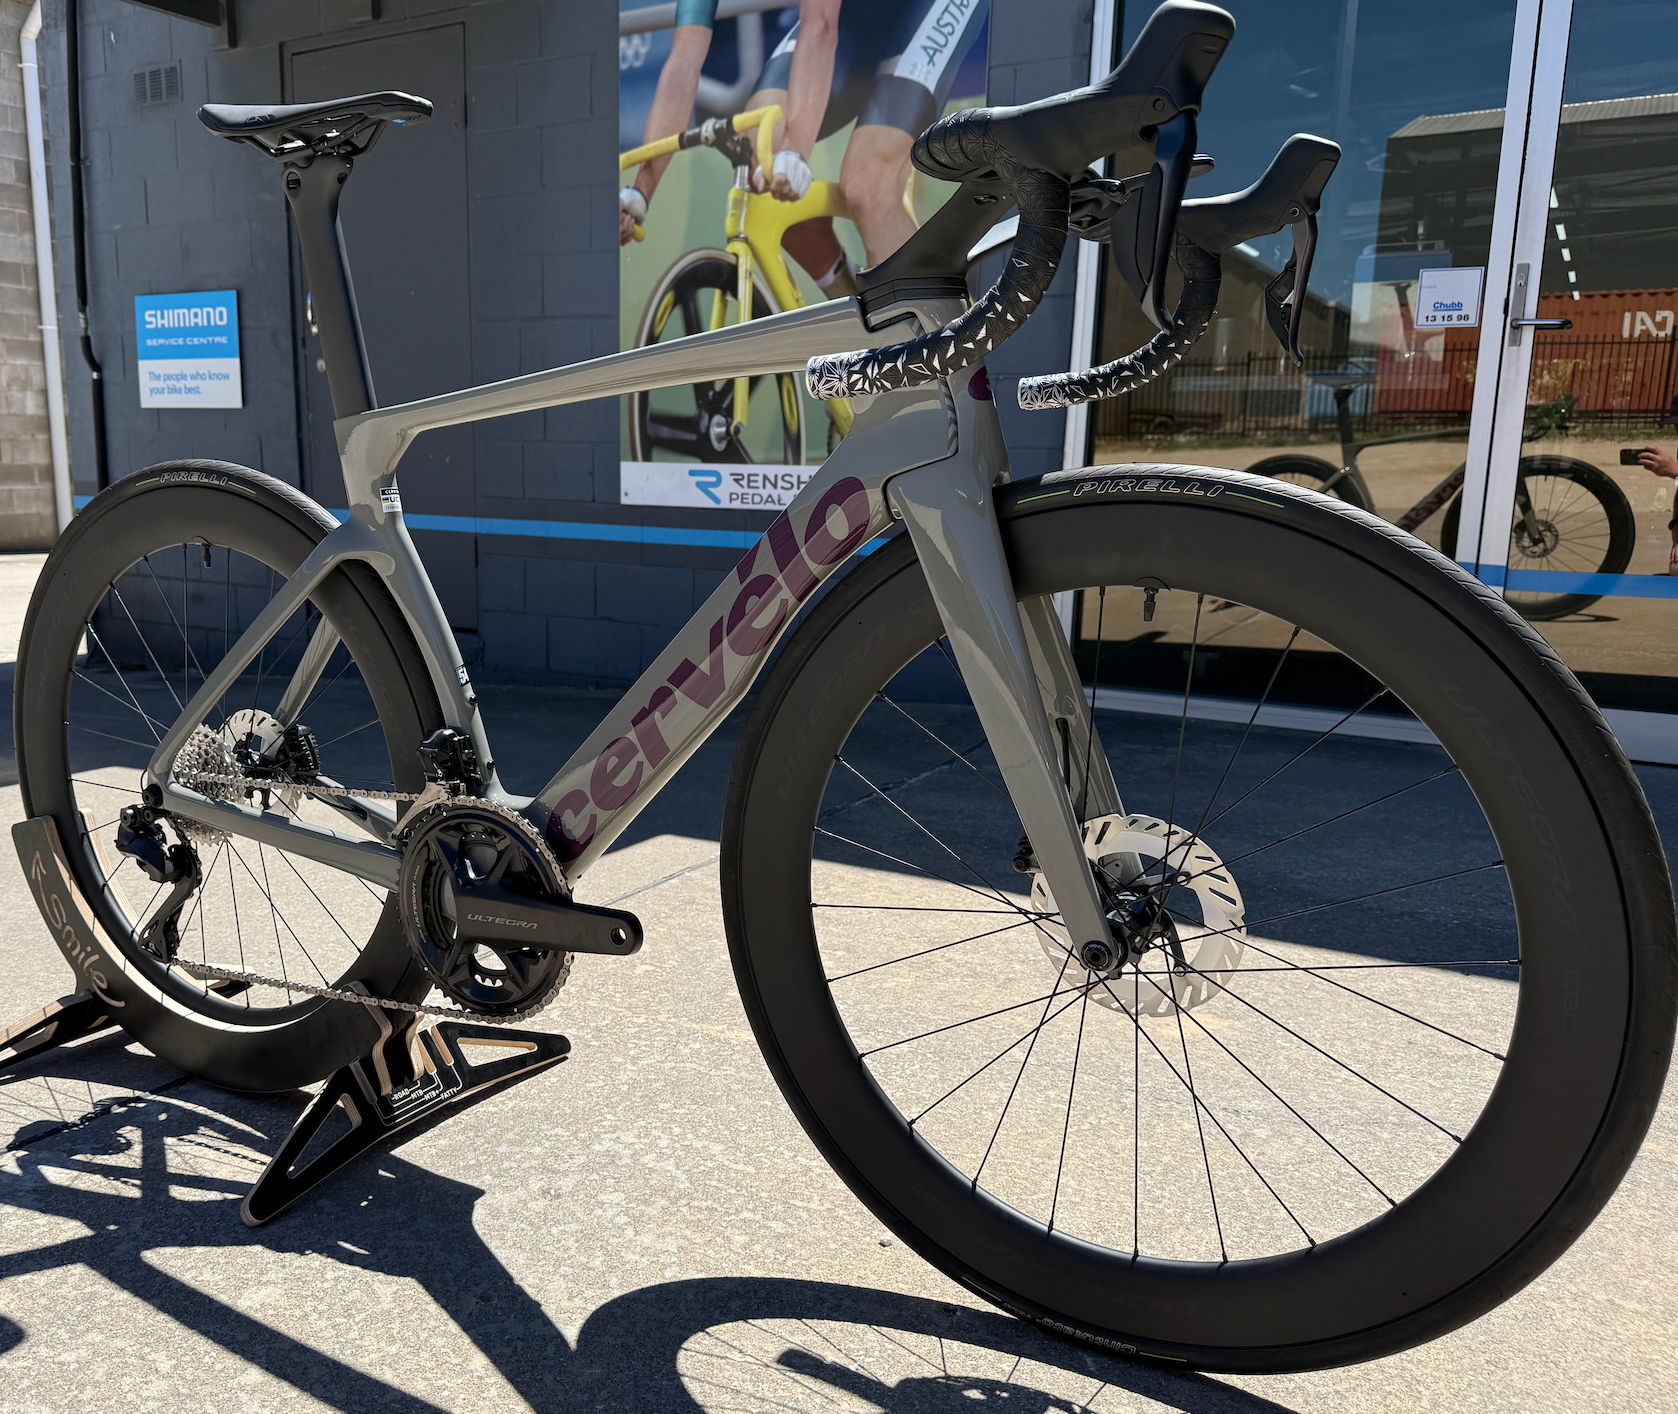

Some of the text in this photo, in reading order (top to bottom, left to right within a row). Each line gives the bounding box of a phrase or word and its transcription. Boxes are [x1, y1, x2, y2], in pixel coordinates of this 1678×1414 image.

[1433, 301, 1463, 310] Chubb
[145, 306, 228, 329] SHIMANO
[1424, 313, 1470, 323] 13 15 98
[146, 336, 229, 346] SERVICE CENTRE
[148, 370, 230, 383] The people who know
[148, 383, 202, 397] your bike best.
[160, 471, 228, 486] PIRELLI
[1073, 479, 1225, 497] PIRELLI
[729, 492, 786, 506] PEDAL
[545, 476, 871, 862] cervélo
[334, 604, 410, 765] ULTEGRA
[778, 622, 887, 800] ULTEGRA
[1439, 682, 1578, 934] ULTEGRA
[411, 882, 420, 928] ULTEGRA
[467, 913, 538, 930] ULTEGRA
[45, 893, 126, 1008] Smile
[394, 1087, 458, 1100] ROAD MTB MTB+ FATTY
